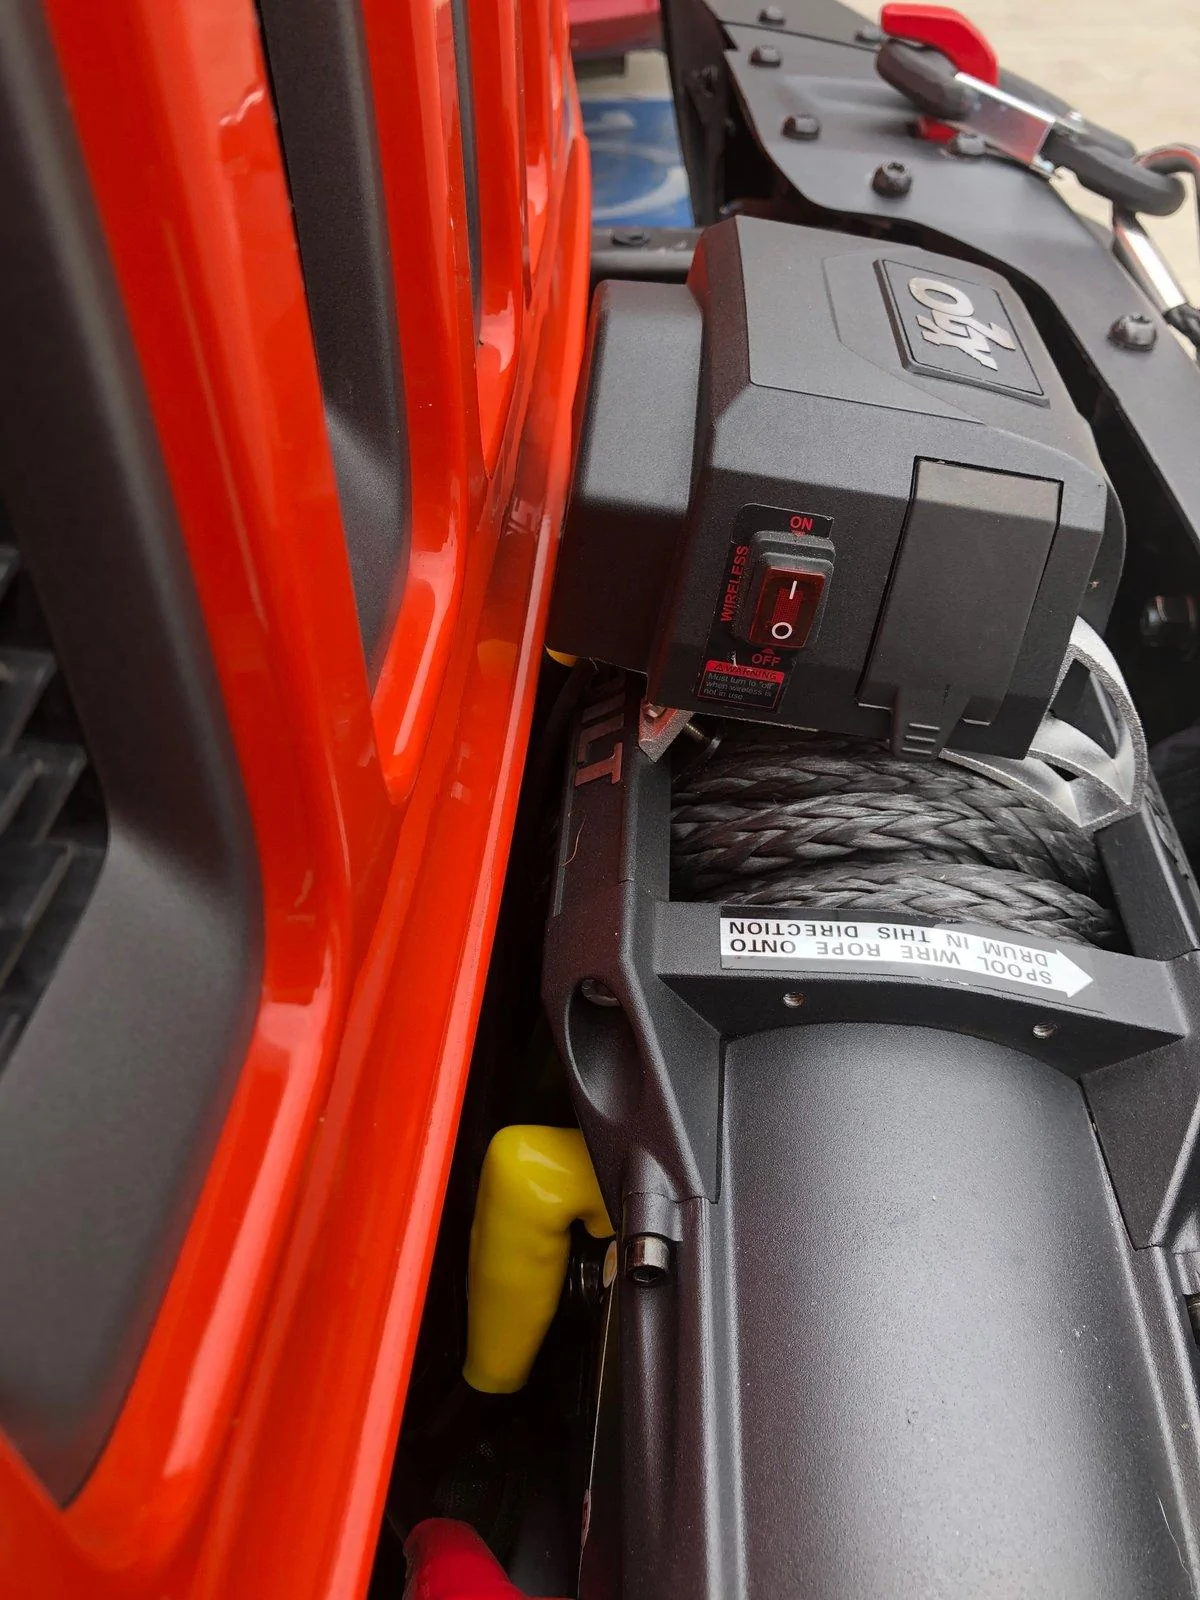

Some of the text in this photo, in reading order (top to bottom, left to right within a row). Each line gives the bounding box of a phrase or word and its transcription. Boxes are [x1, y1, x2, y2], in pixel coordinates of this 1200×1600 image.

[790, 515, 813, 531] ON
[720, 544, 751, 622] WIRELESS
[751, 653, 781, 667] OFF
[707, 672, 729, 682] Must
[730, 676, 747, 686] turn
[748, 679, 757, 687] to
[725, 664, 777, 680] WARNING
[703, 687, 717, 696] not
[718, 689, 726, 697] in
[705, 680, 772, 697] when wireless is
[729, 921, 1049, 967] DRUM IN THIS DIRECTION
[730, 938, 1053, 985] SPOOL WIRE ROPE ONTO
